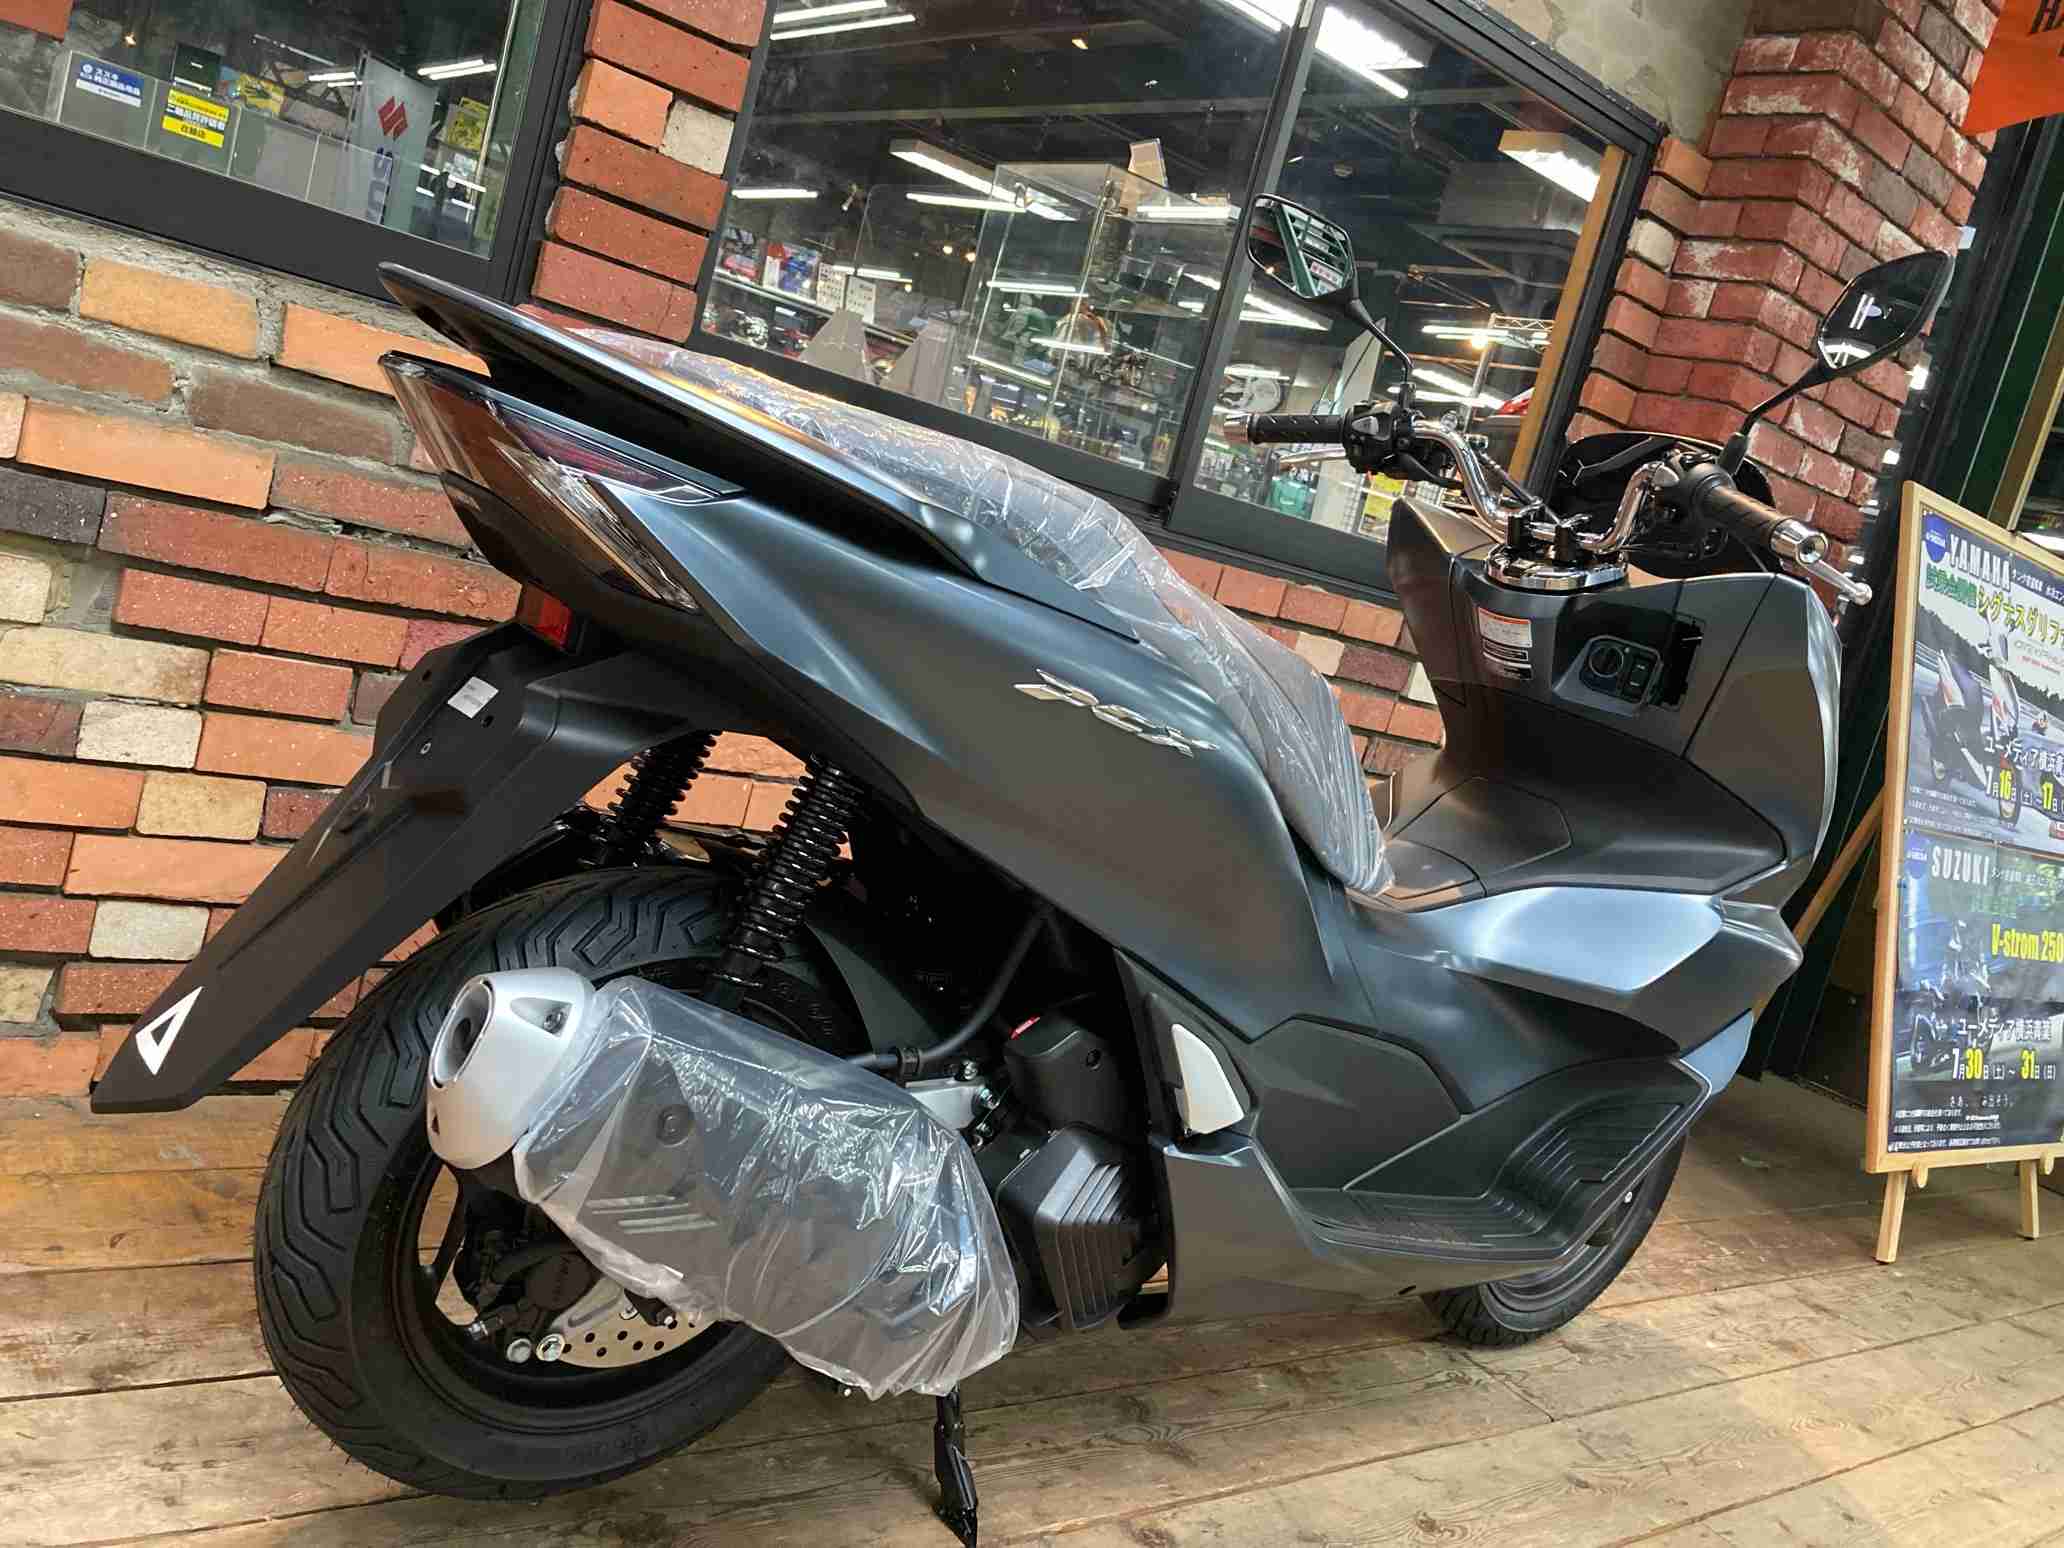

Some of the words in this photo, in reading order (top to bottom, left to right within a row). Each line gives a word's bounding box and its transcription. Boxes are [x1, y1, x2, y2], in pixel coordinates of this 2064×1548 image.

[1950, 533, 2011, 592] YAMAHA
[1931, 845, 1990, 887] SUZUKI
[1991, 923, 2040, 961] V-strom
[2041, 930, 2064, 964] 250
